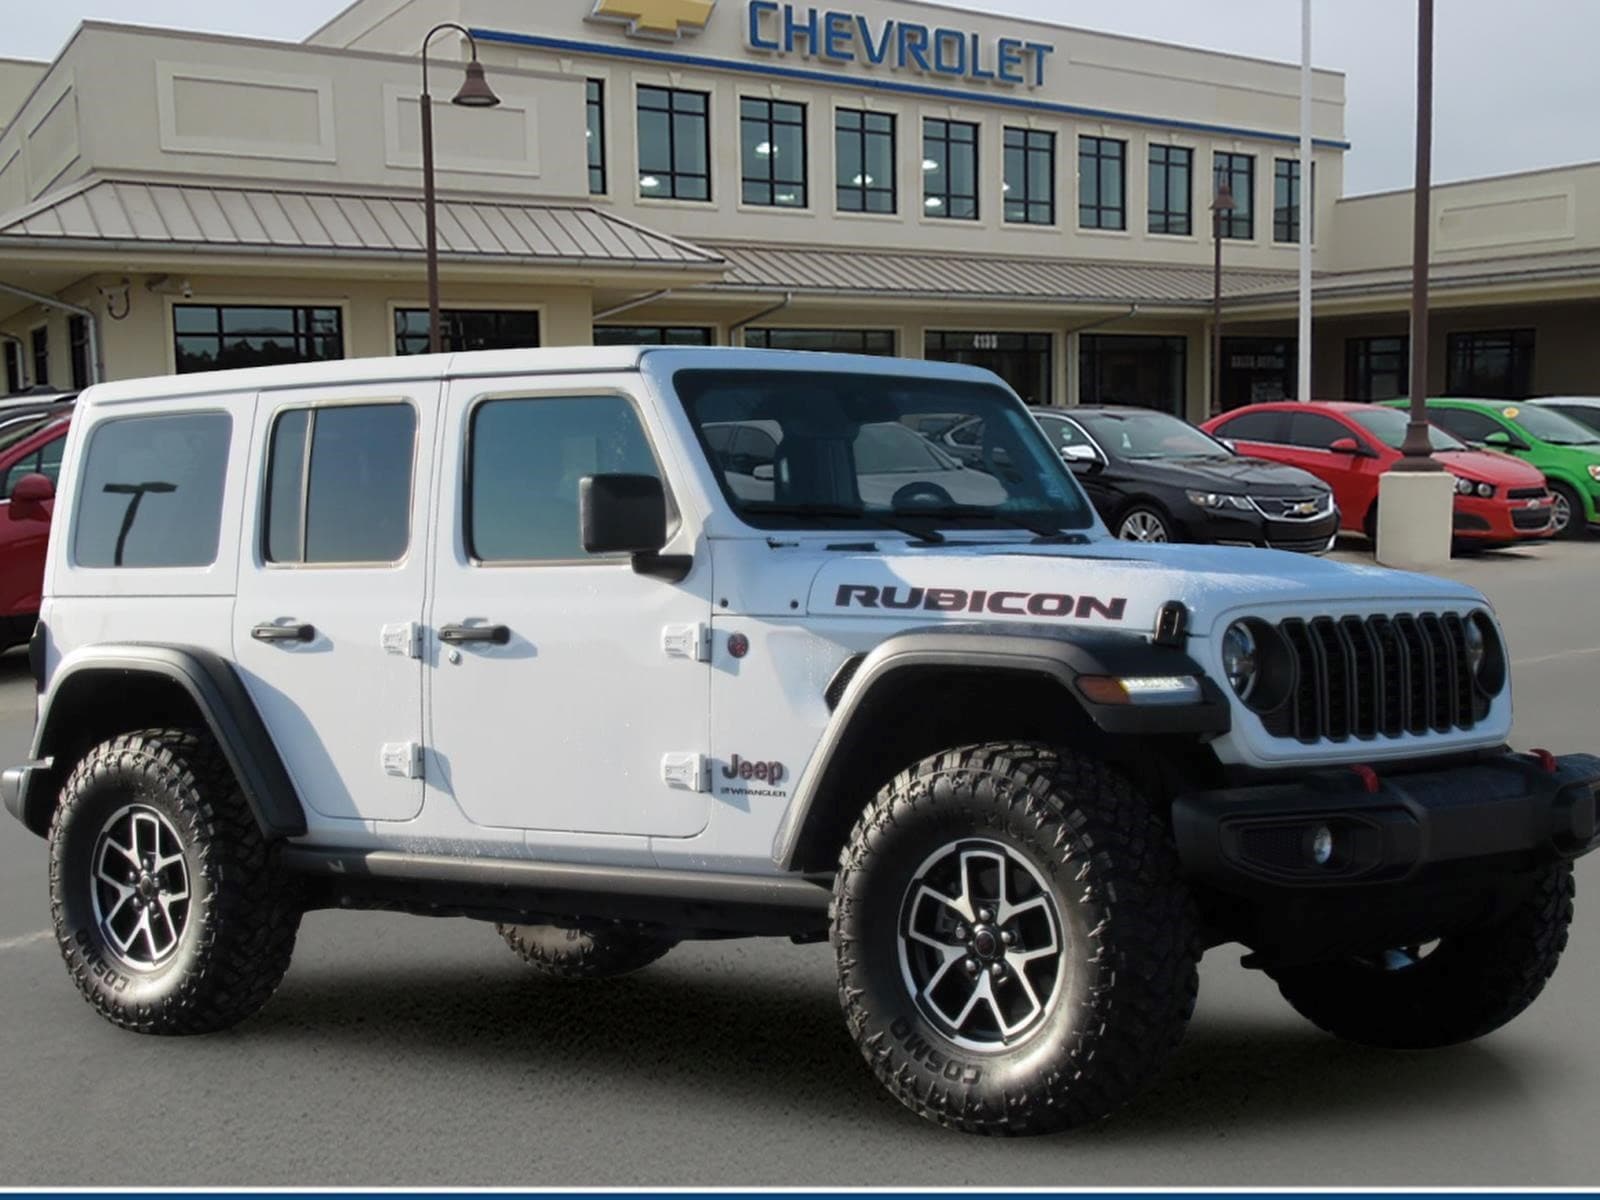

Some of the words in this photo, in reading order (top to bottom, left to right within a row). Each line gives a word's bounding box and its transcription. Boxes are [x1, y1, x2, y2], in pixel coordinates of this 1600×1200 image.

[747, 0, 1055, 87] CHEVROLET
[835, 584, 1127, 620] RUBICON
[721, 753, 784, 786] Jeep
[731, 787, 787, 797] WRANGLER
[889, 1017, 984, 1086] COSMO
